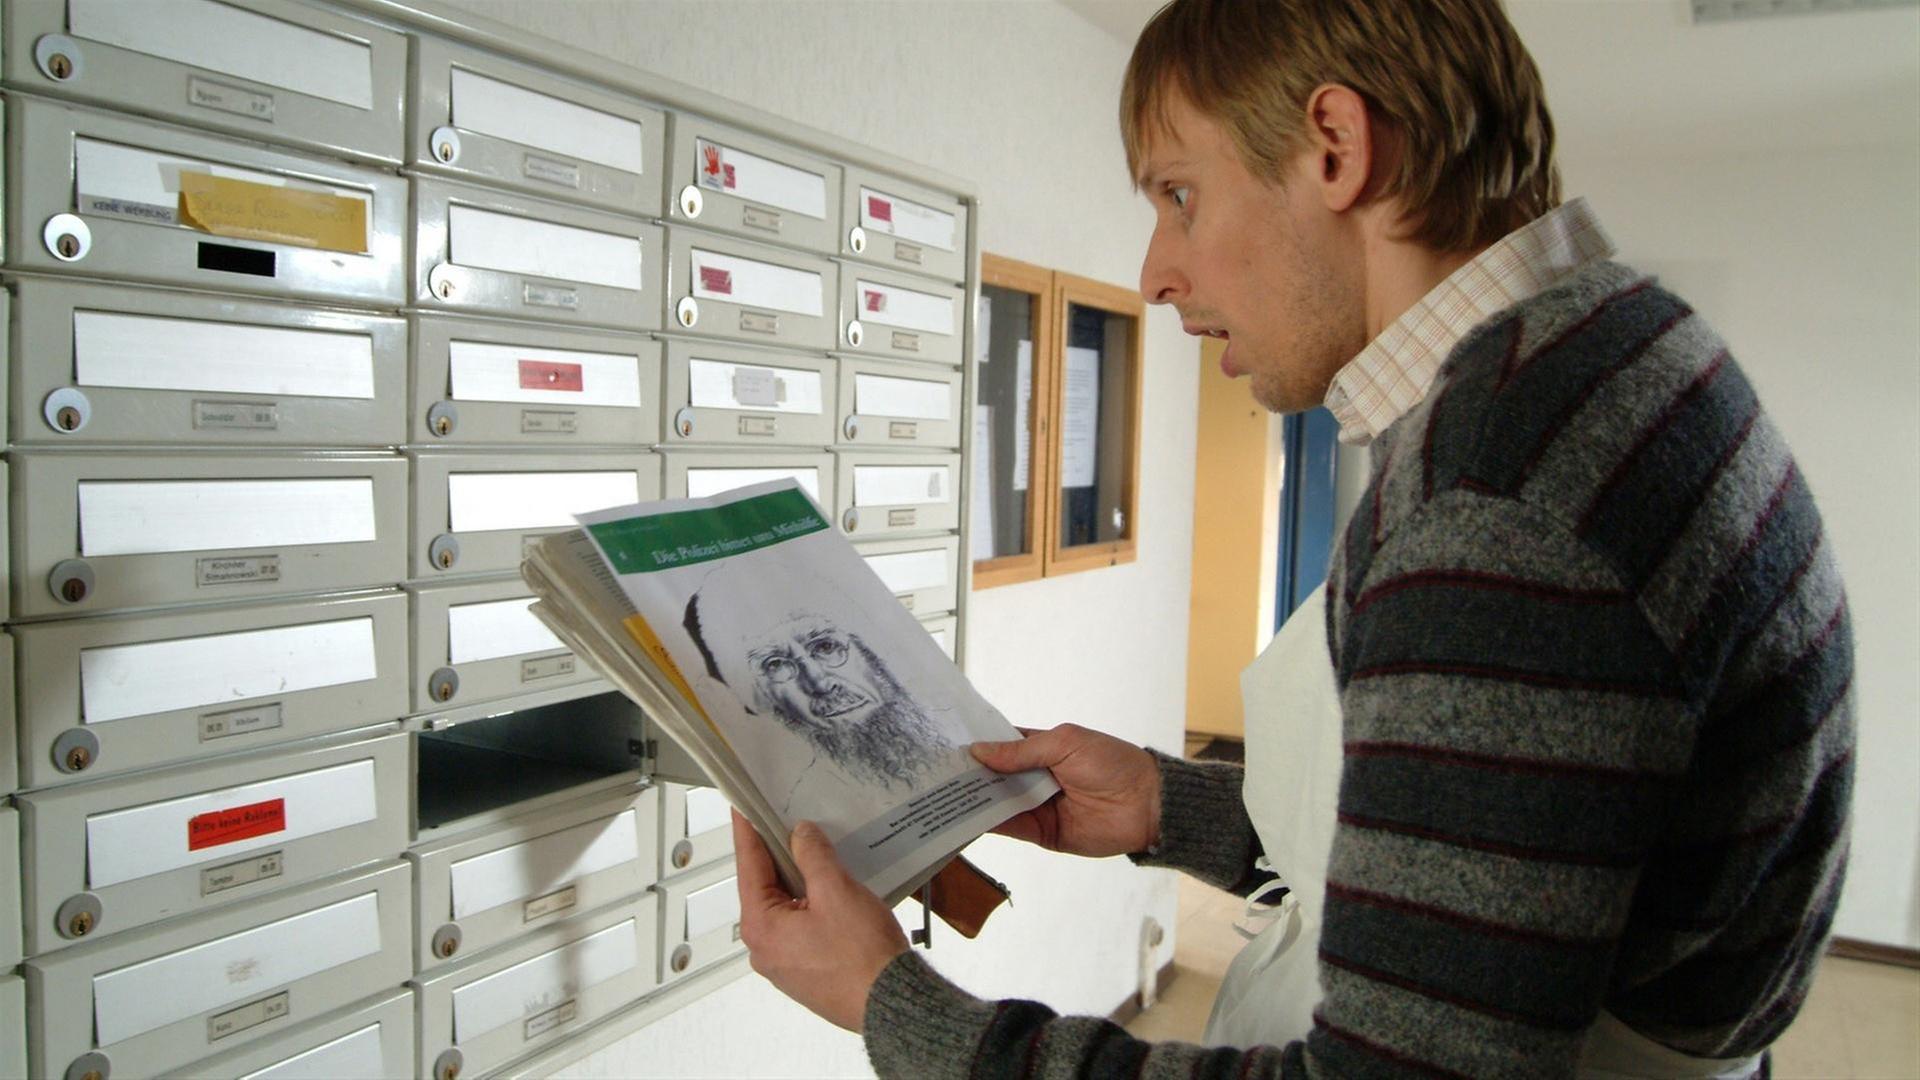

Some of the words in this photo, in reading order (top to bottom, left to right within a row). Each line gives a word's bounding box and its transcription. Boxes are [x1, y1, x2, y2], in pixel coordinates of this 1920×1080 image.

[93, 201, 119, 213] KEINE
[122, 204, 172, 220] WERBUNG
[651, 549, 679, 565] Die
[677, 541, 721, 560] Polizei
[751, 531, 775, 544] um
